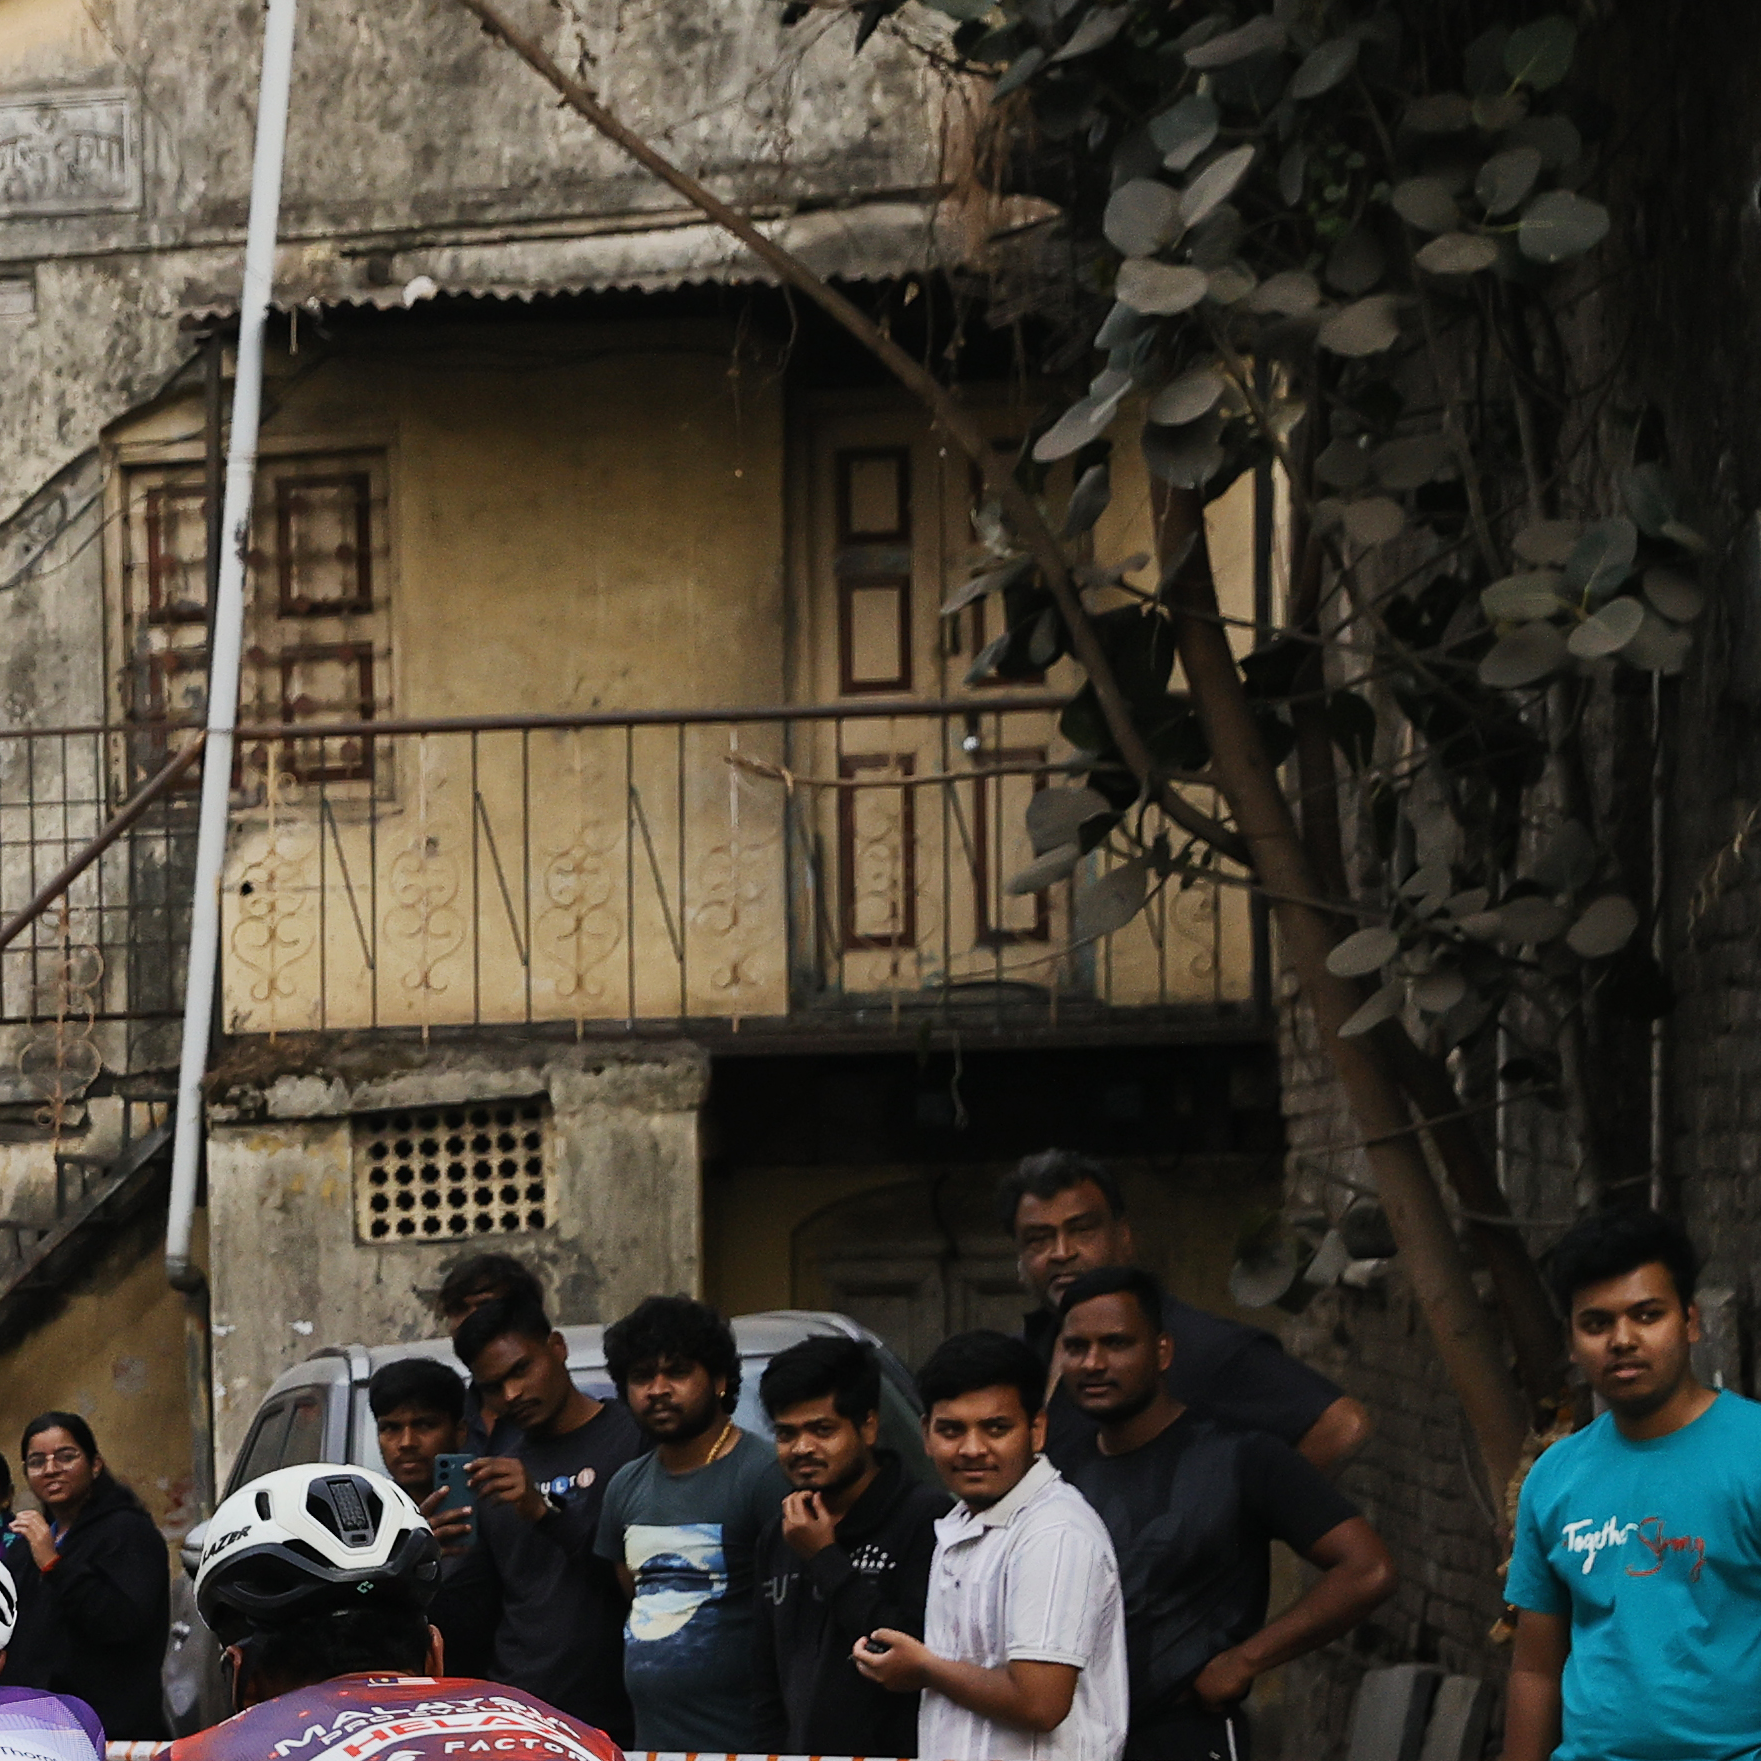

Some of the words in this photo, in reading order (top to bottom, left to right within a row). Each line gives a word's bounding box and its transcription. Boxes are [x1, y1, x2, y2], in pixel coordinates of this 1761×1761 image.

[202, 1525, 252, 1565] LAZER
[1562, 1515, 1638, 1575] Together
[324, 1713, 396, 1746] PRO
